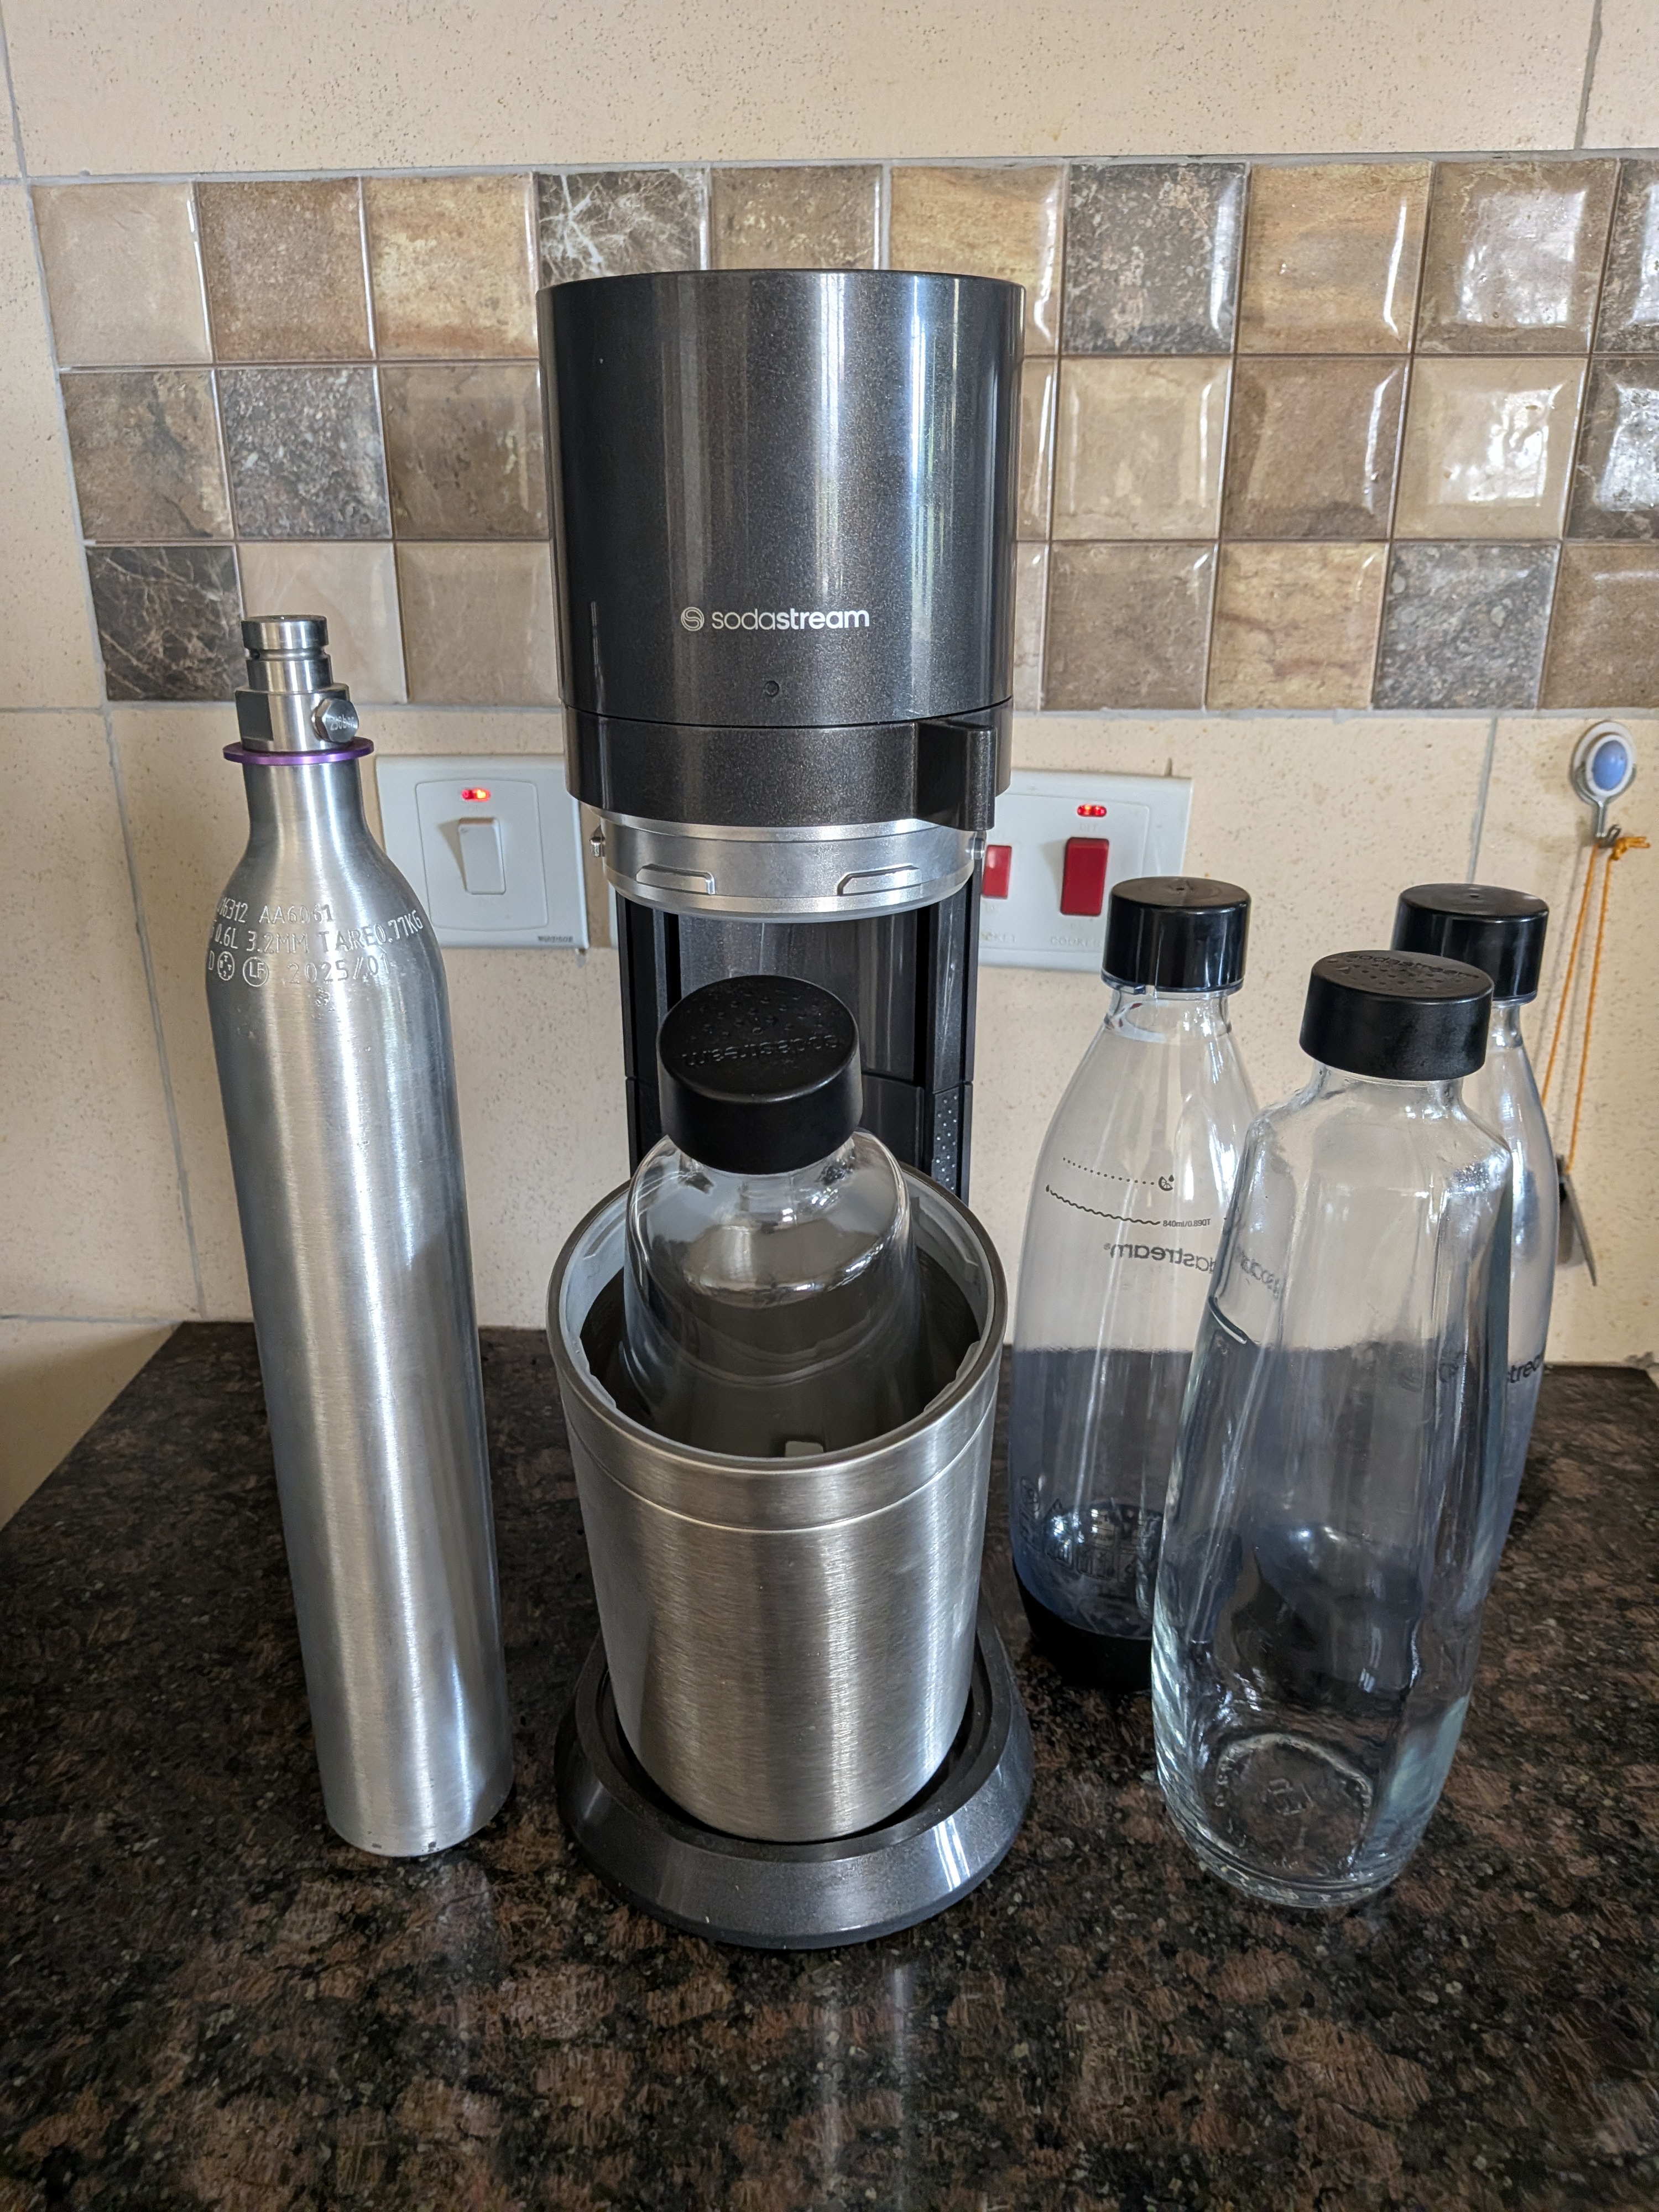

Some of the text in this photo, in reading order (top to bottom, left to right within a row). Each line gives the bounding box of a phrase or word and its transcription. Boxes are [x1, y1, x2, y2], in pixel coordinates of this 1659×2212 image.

[711, 608, 870, 630] sodastream
[258, 903, 334, 924] AA6061
[246, 930, 309, 953] 3.2MM
[288, 953, 389, 984] 2025/01
[1345, 953, 1480, 979] sodastream
